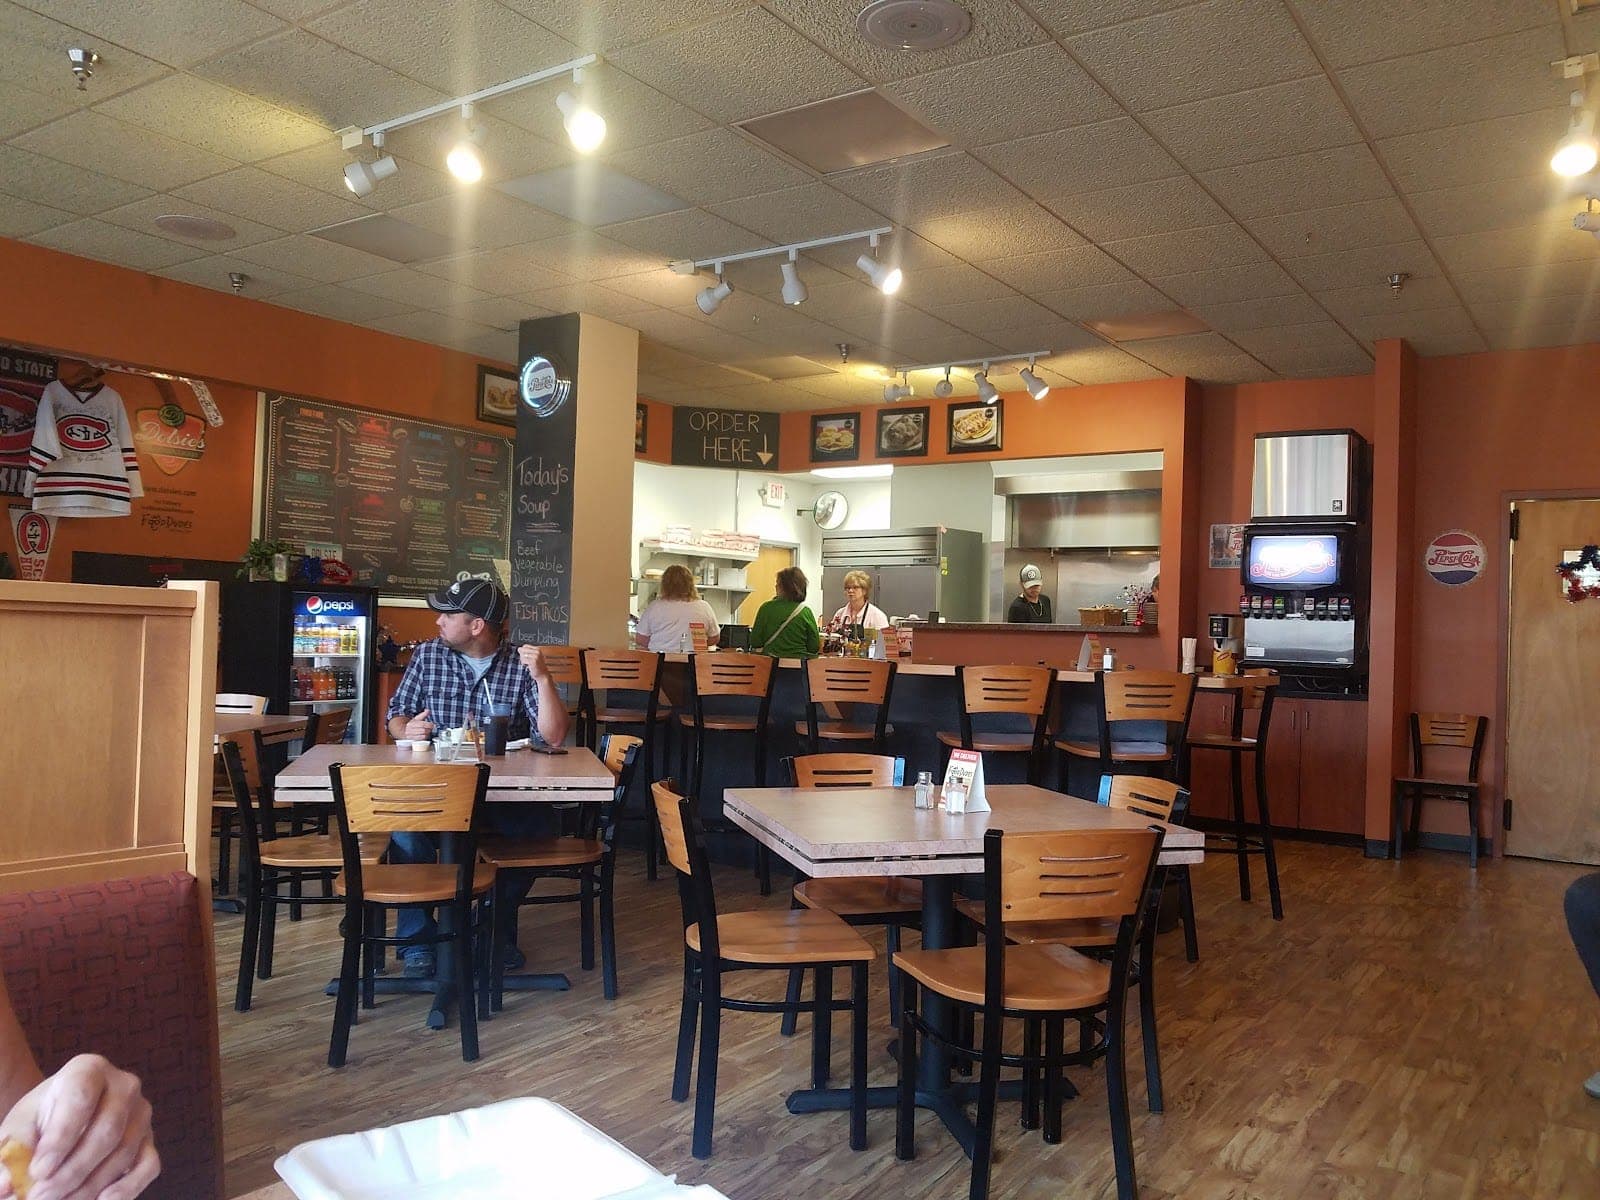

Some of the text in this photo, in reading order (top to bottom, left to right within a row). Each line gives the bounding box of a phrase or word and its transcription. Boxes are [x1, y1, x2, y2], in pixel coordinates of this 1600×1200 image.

[15, 358, 55, 380] STATE
[689, 411, 761, 433] ORDER
[703, 435, 753, 463] HERE
[515, 456, 569, 495] Today's
[770, 484, 783, 500] EXIT
[518, 494, 551, 520] Soup
[517, 539, 543, 556] Beef
[323, 599, 355, 612] pepsi
[512, 601, 539, 622] FISH
